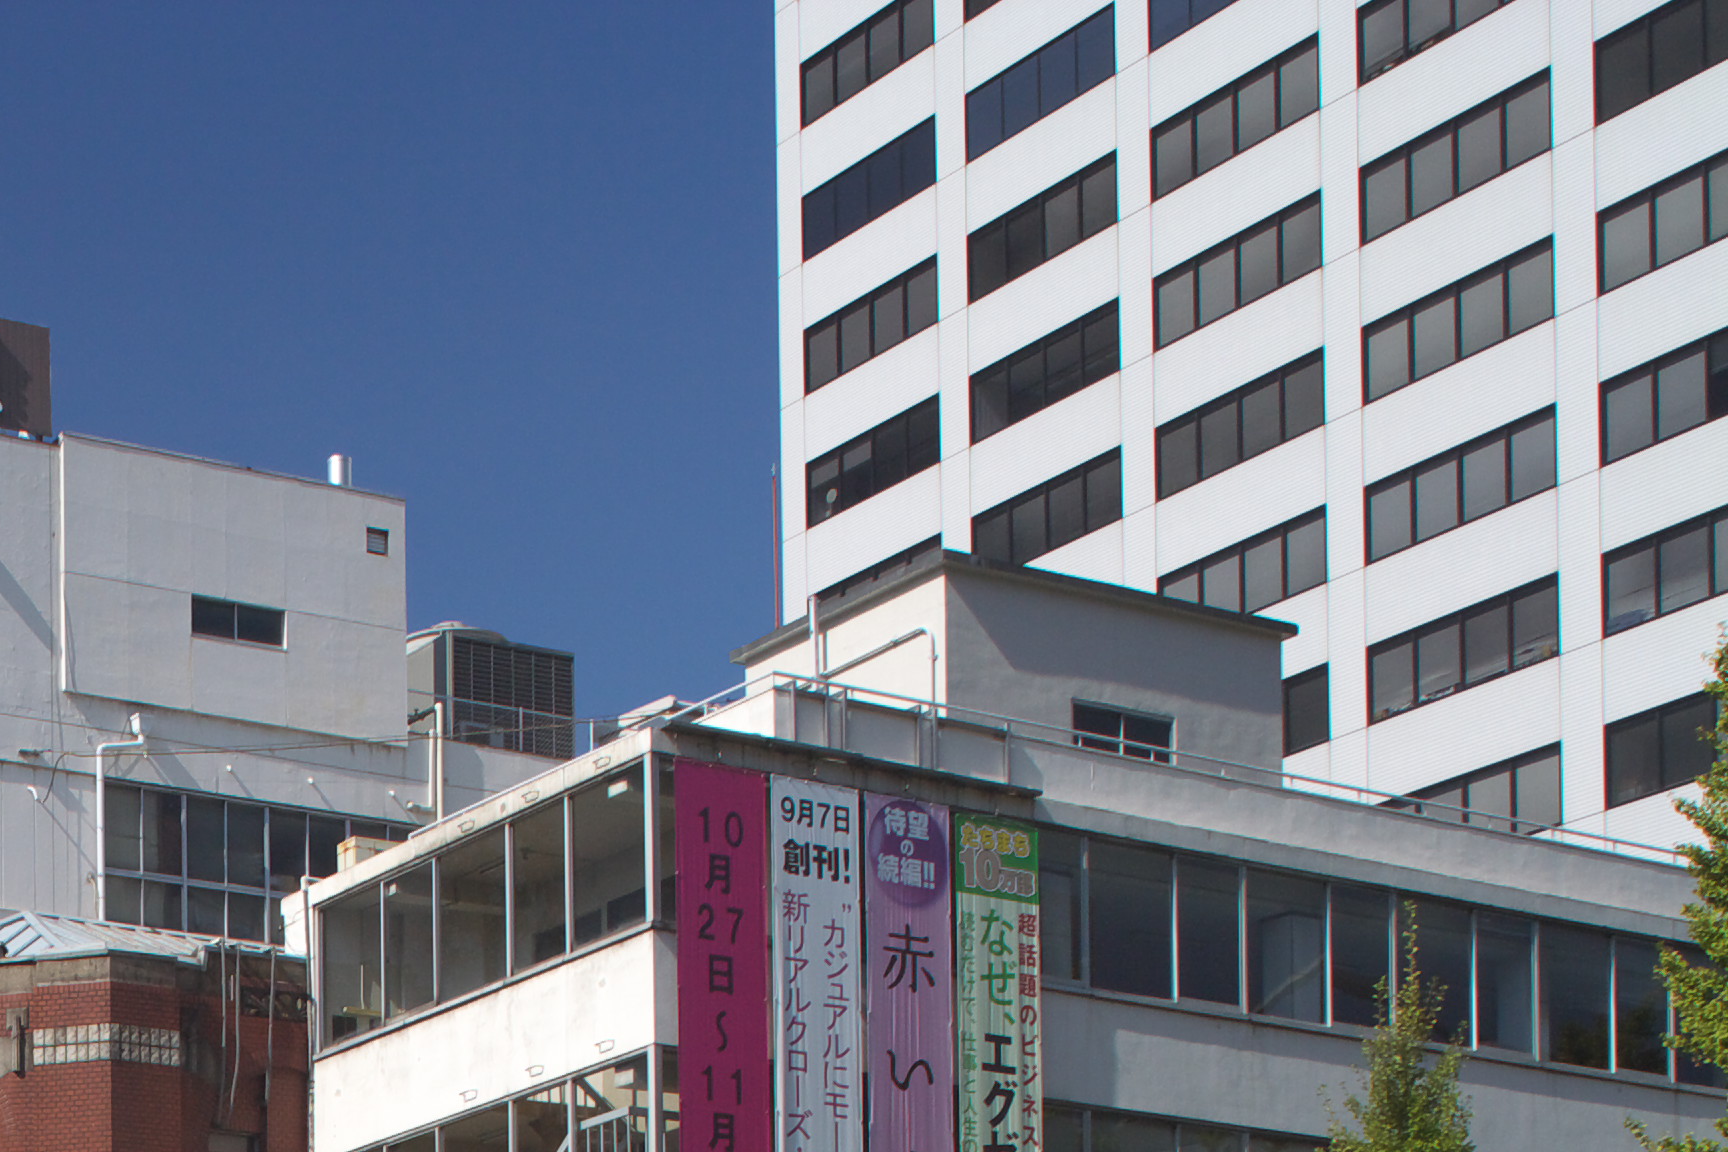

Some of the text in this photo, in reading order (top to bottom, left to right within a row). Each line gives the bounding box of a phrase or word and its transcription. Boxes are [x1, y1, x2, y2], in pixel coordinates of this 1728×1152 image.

[780, 796, 851, 835] 9月7日
[883, 806, 930, 841] 待望
[899, 838, 914, 857] の
[960, 821, 1031, 859] たちまち
[958, 847, 1037, 898] 10万部
